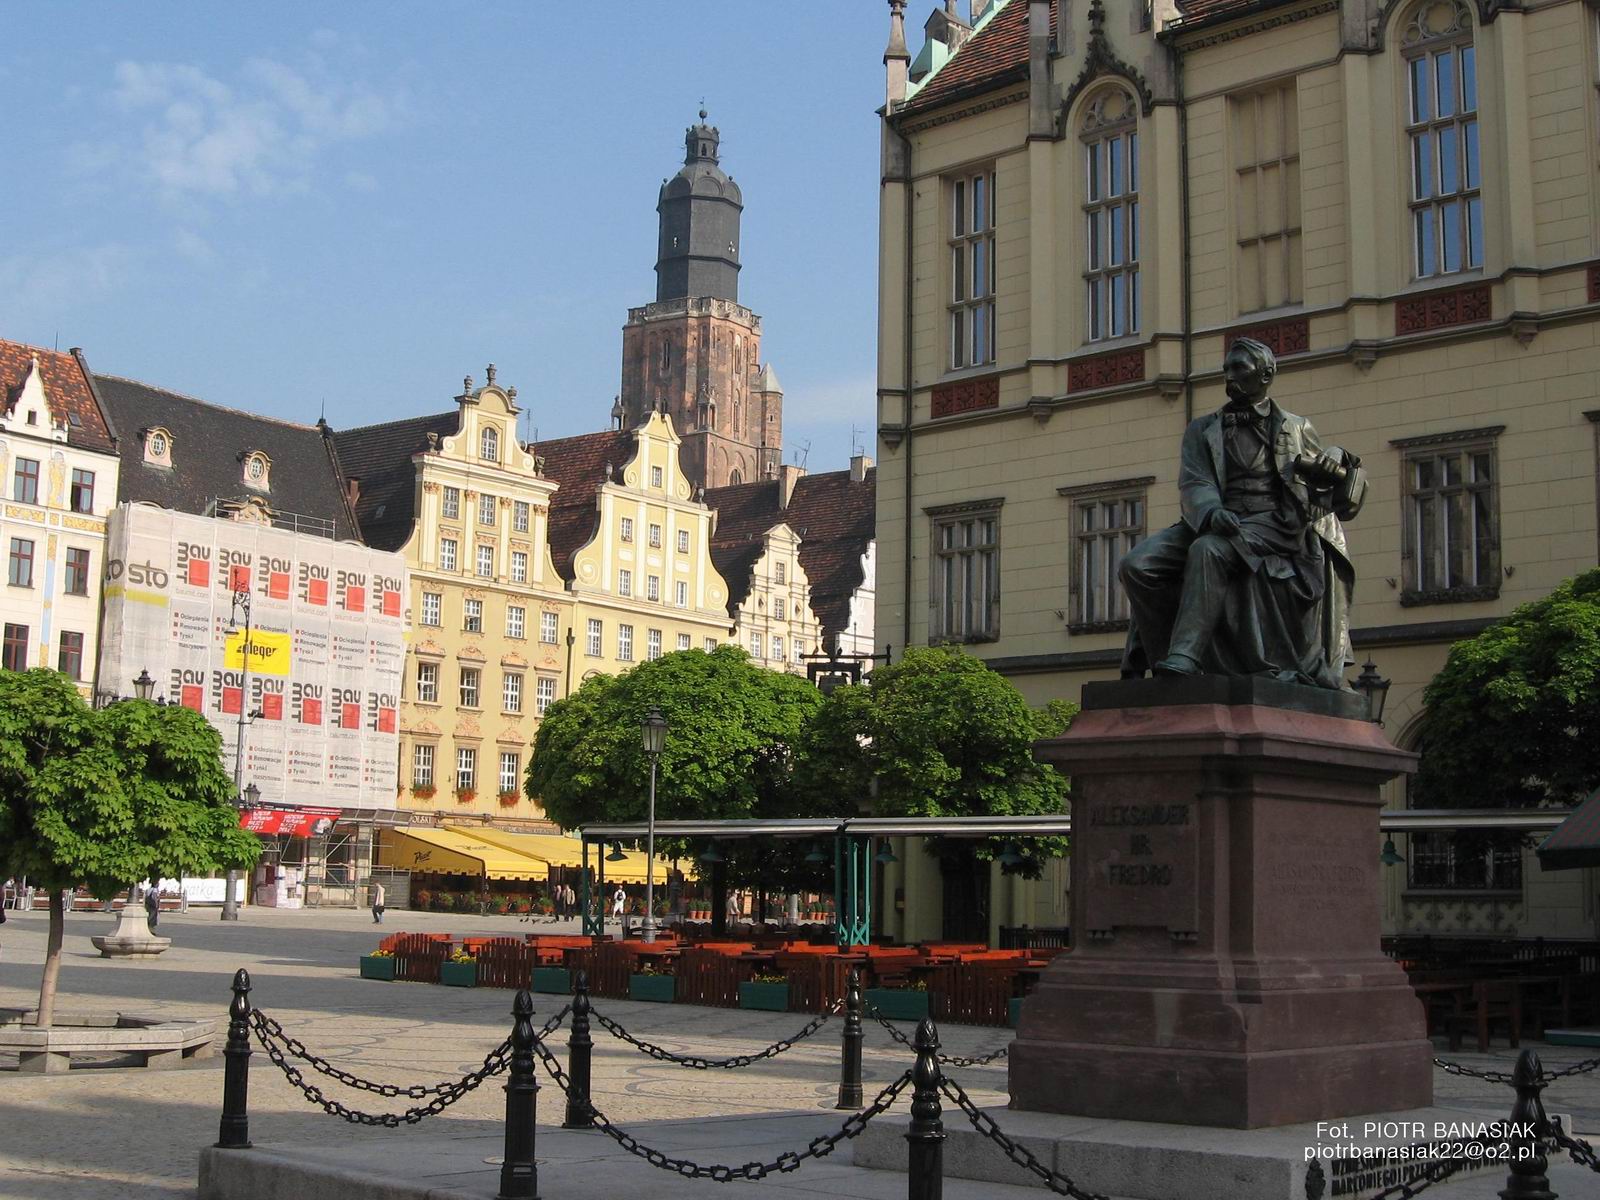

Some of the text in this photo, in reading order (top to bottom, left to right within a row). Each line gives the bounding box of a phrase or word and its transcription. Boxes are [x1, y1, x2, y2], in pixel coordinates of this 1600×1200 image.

[128, 560, 168, 588] sto
[1090, 804, 1190, 826] ALEKSANDER
[1110, 865, 1173, 886] FREDRO
